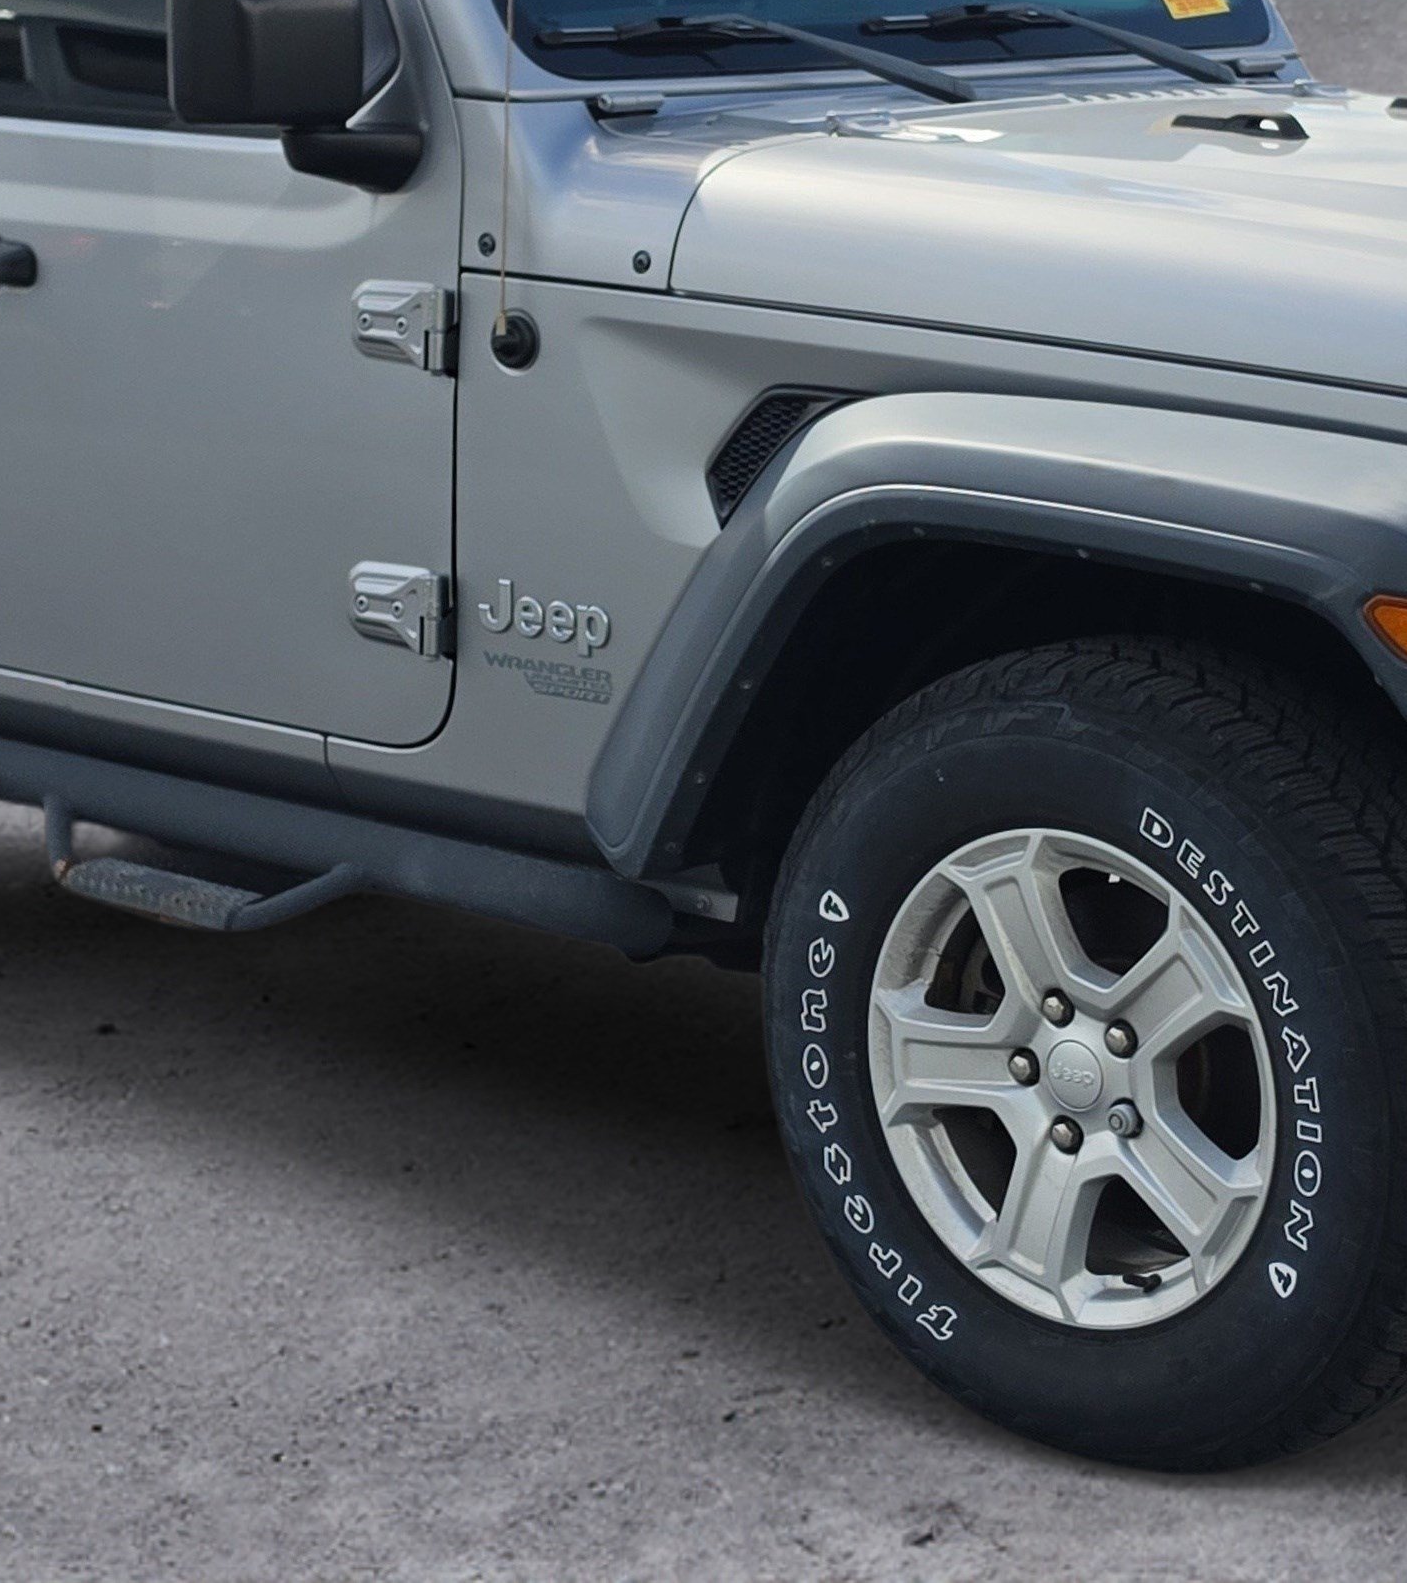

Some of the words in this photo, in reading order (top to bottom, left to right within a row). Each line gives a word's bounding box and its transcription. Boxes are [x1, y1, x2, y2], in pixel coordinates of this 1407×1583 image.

[478, 578, 611, 658] Jeep
[482, 649, 612, 683] WRANGLER
[1138, 806, 1324, 1253] DESTINATION
